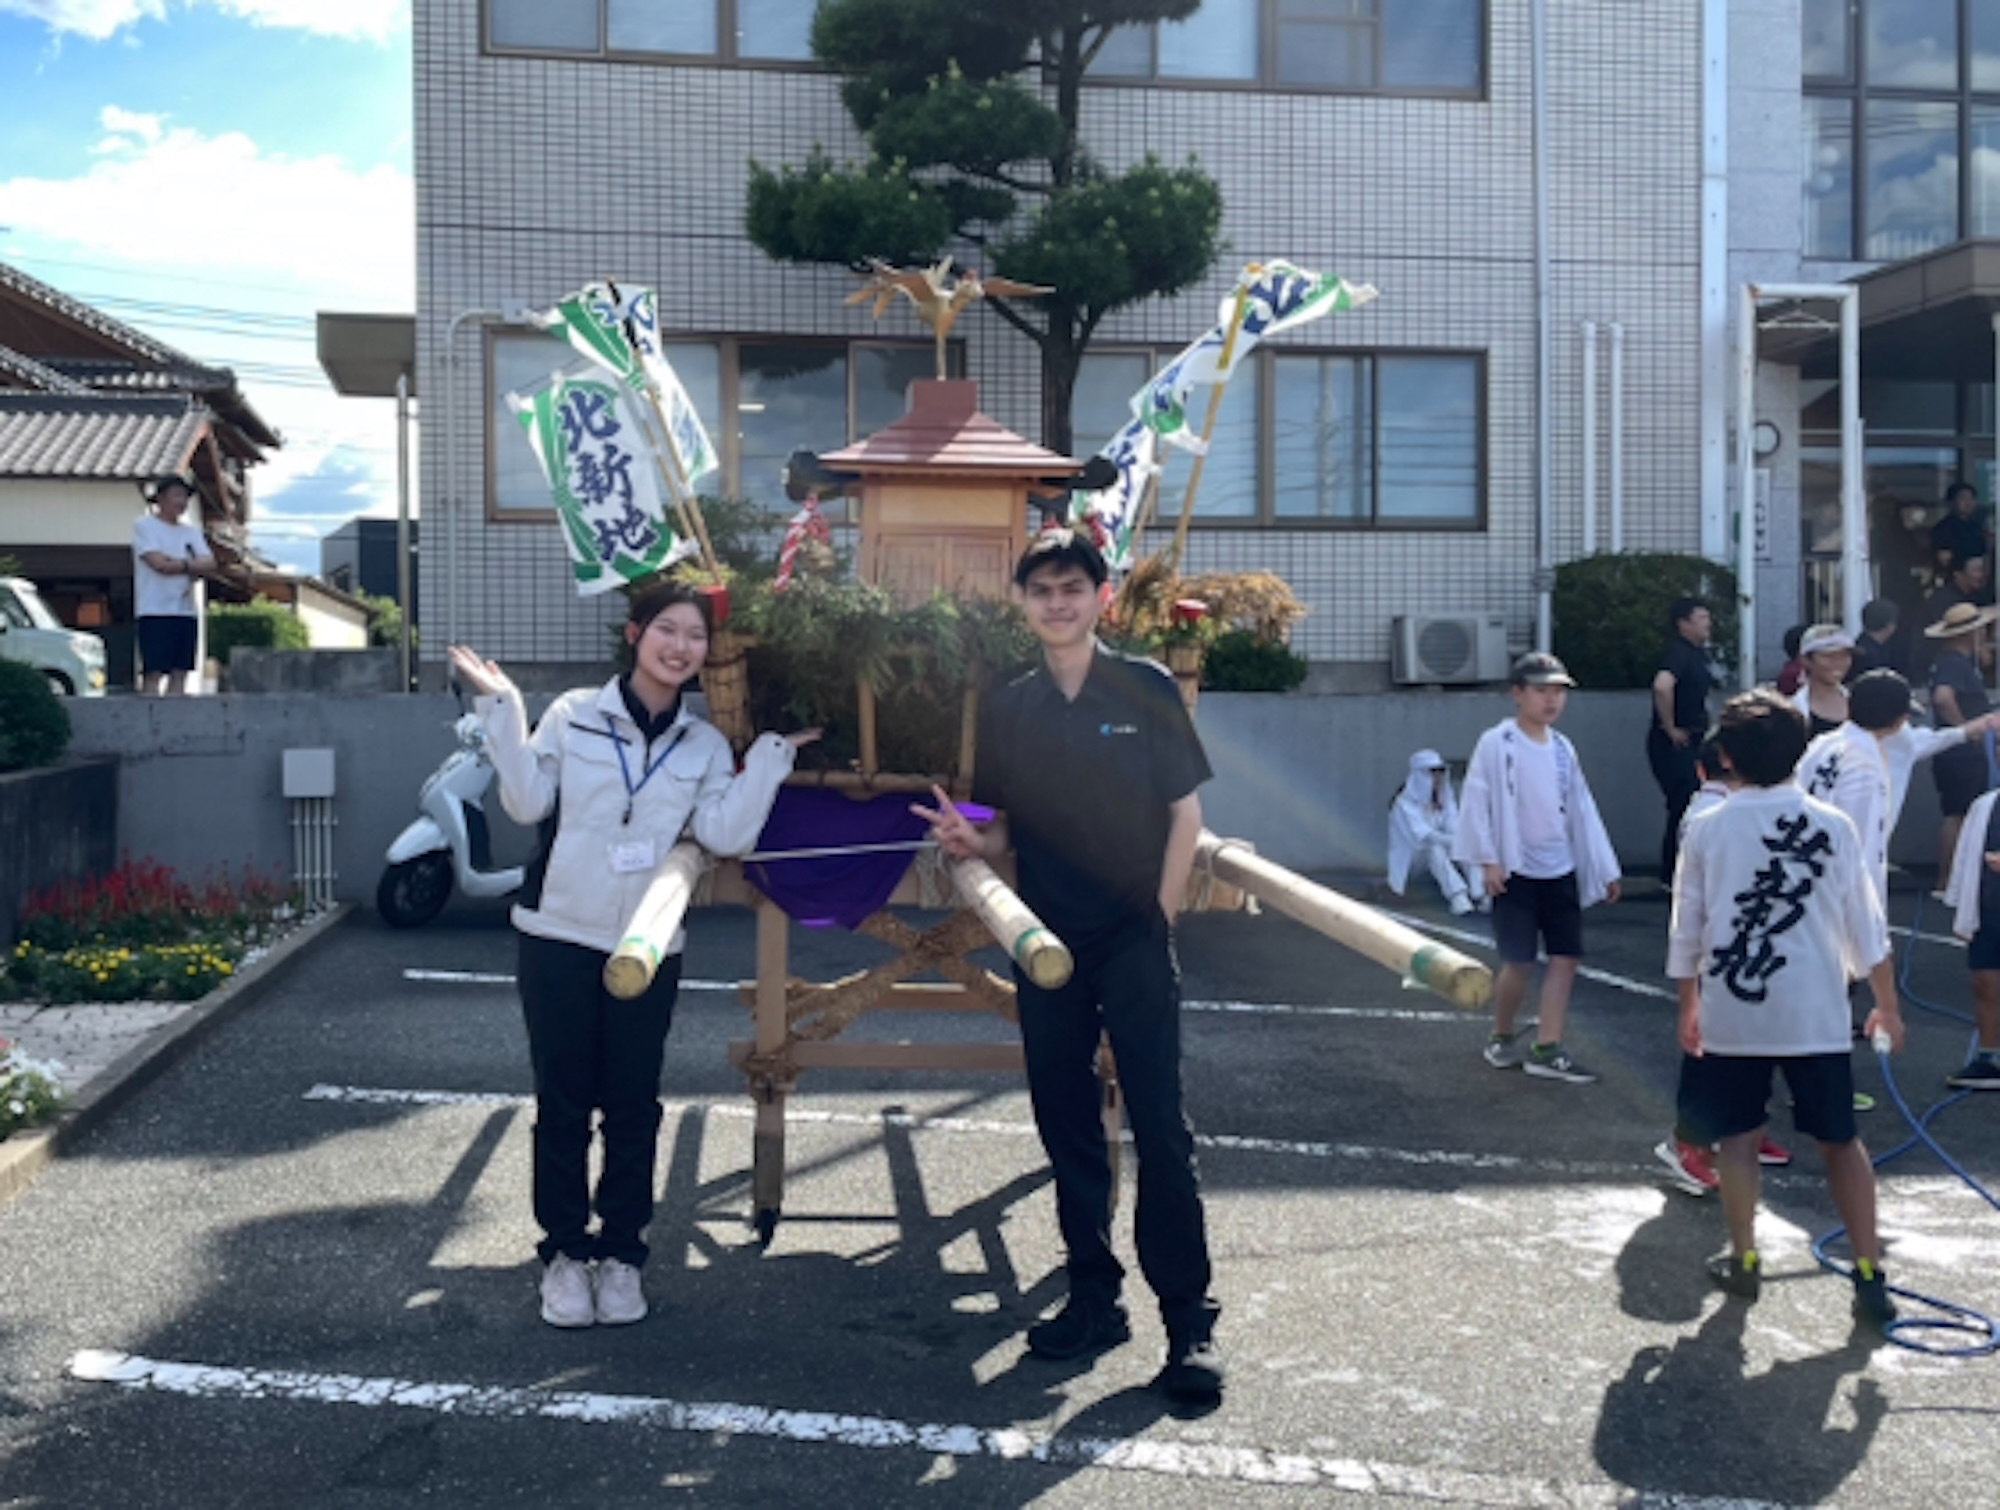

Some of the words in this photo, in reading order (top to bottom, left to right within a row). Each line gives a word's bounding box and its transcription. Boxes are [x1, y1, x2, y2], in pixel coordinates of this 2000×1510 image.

[559, 390, 658, 561] 北新地
[1708, 812, 1834, 1004] 北新地
